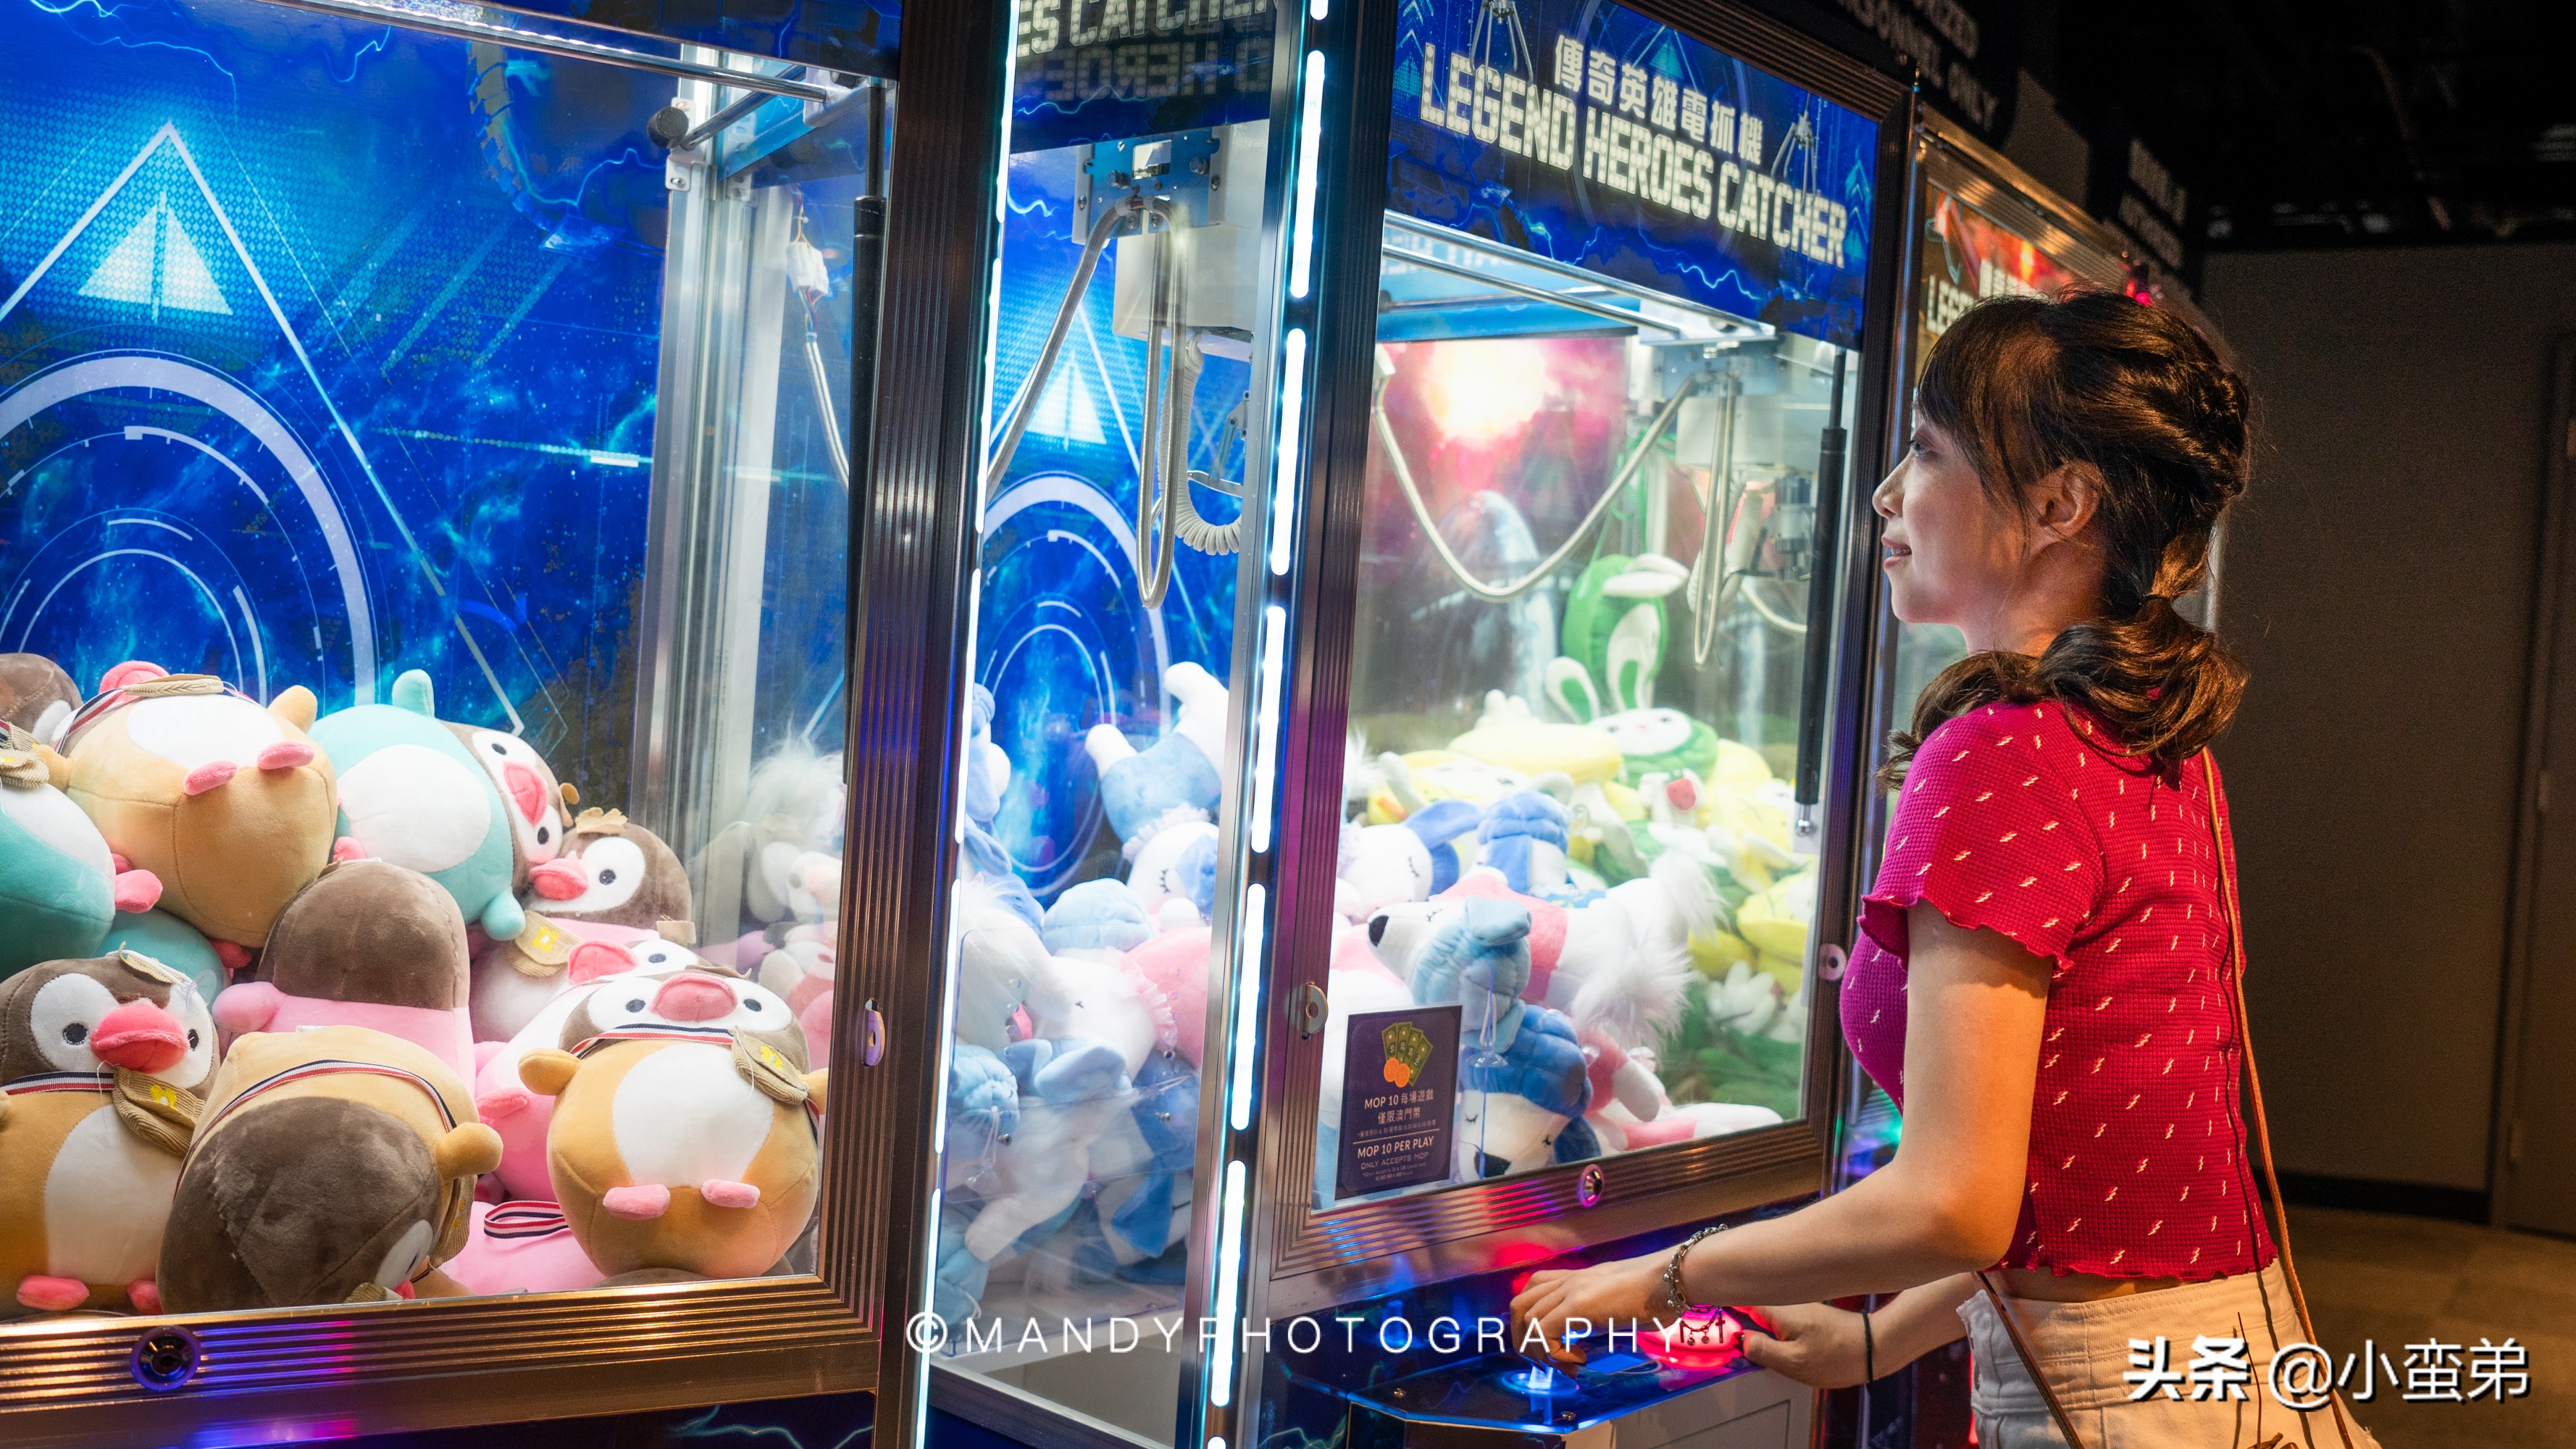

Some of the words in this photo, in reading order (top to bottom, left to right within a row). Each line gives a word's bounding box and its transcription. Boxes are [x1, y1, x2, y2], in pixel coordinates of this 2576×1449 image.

[1552, 34, 1763, 165] 傳奇英雄電抓機
[1421, 42, 1576, 171] LEGEND
[1583, 106, 1714, 220] HEROES
[1717, 160, 1847, 270] CATCHER
[1364, 1096, 1387, 1109] MOP
[1388, 1094, 1399, 1106] 10
[1400, 1088, 1434, 1105] 每場遊戲
[1378, 1106, 1421, 1124] 僅限澳門幣
[1357, 1145, 1380, 1158] MOP
[1381, 1143, 1392, 1154] 10
[1394, 1139, 1410, 1153] PER
[1413, 1135, 1434, 1149] PLAY
[1360, 1160, 1379, 1169] ONLY
[1381, 1154, 1412, 1166] ACCEPTS
[1413, 1151, 1429, 1161] MOP
